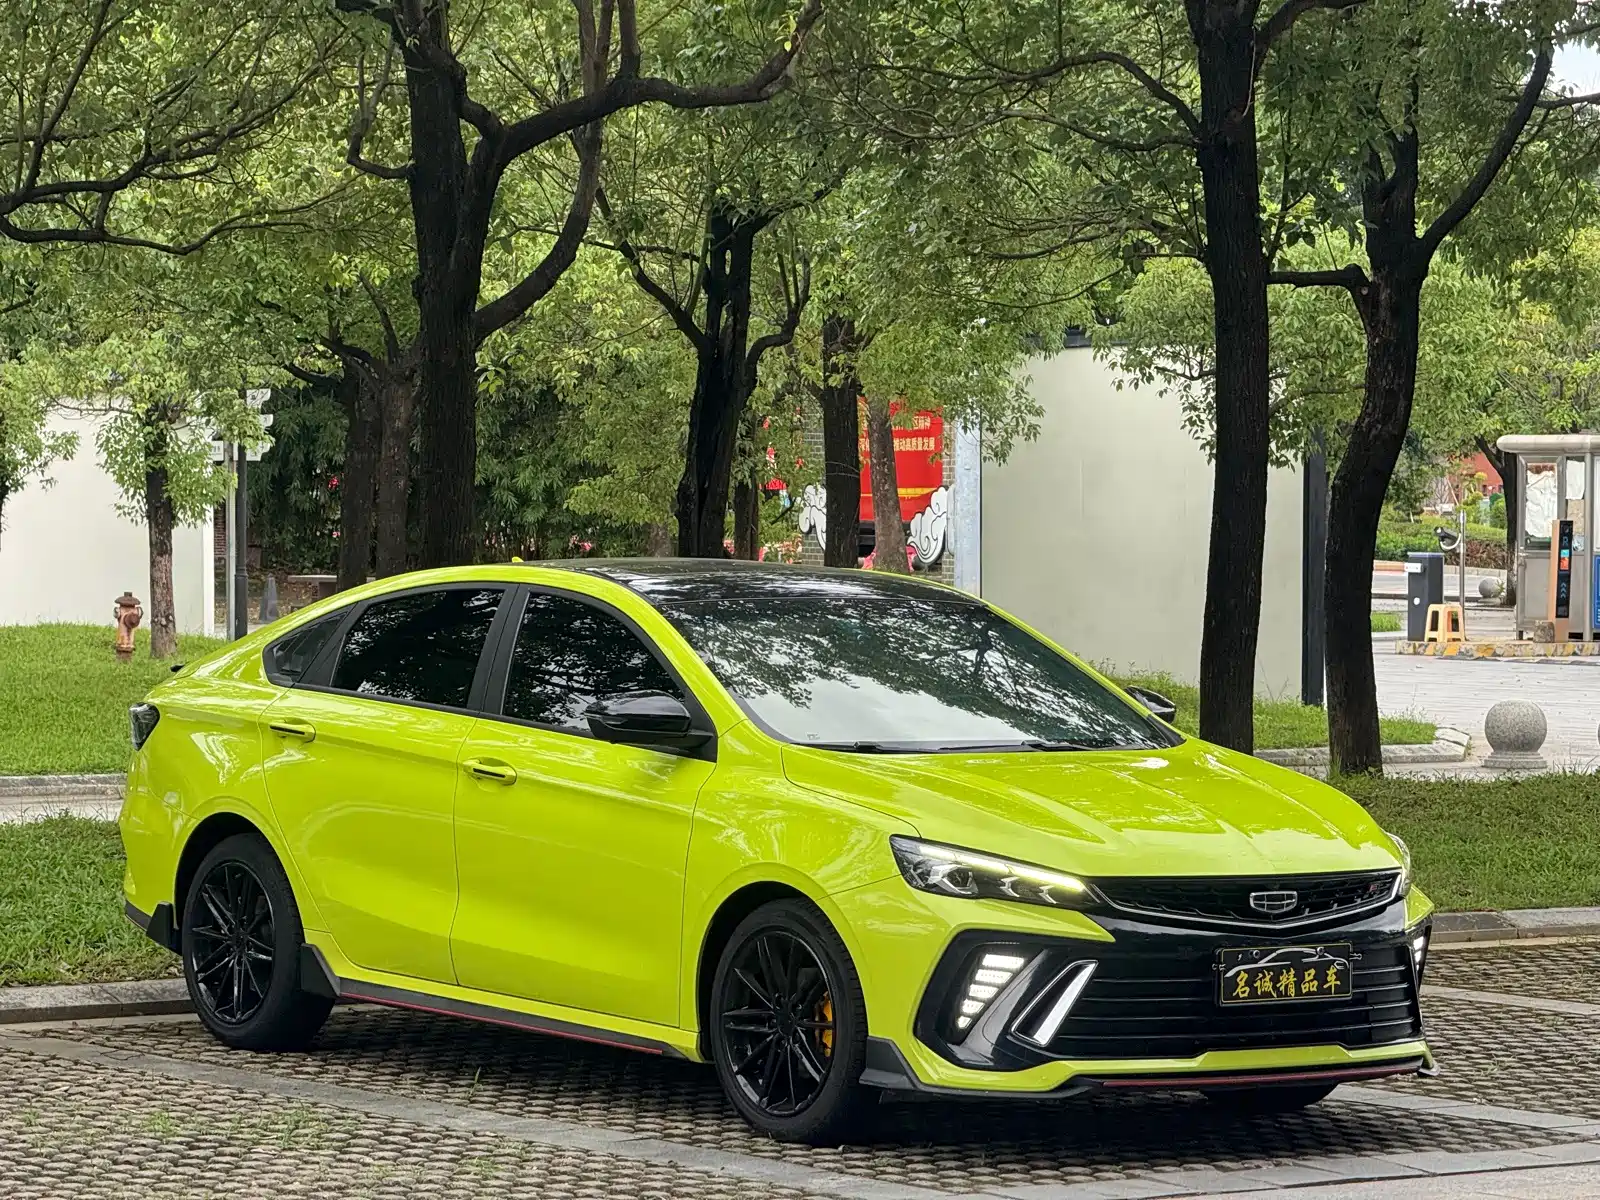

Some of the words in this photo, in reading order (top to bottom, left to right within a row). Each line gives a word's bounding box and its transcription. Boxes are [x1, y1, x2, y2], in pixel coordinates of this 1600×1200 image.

[894, 437, 935, 451] 推动高质量发展
[1233, 965, 1341, 998] 名诚精品车
